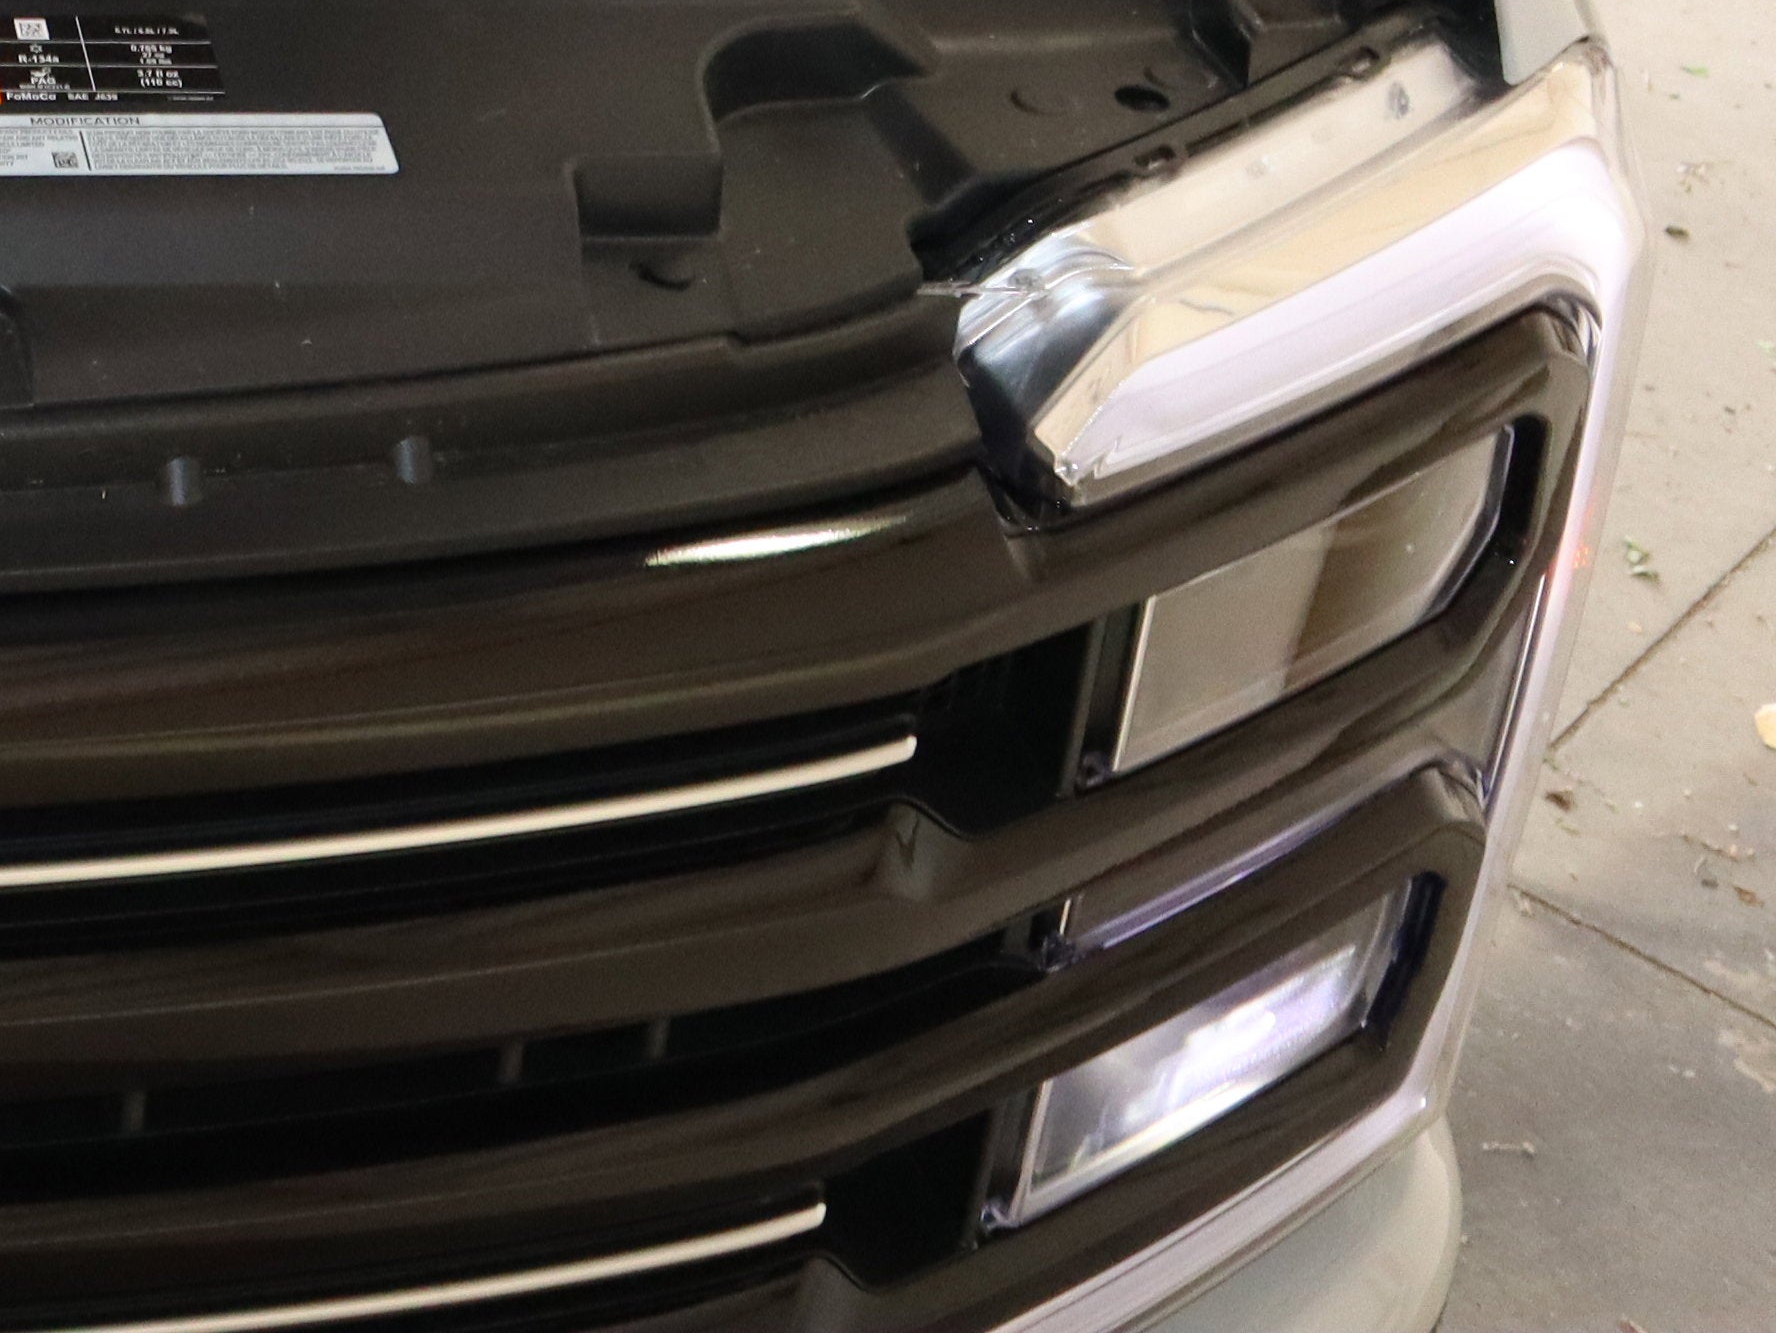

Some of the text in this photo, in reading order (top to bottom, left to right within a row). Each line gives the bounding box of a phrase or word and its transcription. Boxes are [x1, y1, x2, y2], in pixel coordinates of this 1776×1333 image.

[159, 44, 172, 54] kg
[18, 54, 59, 64] R-134a
[165, 70, 179, 78] oz
[30, 76, 56, 85] PAG
[165, 78, 183, 89] cc)
[6, 92, 56, 101] FoMoCo
[67, 93, 89, 101] SAE
[30, 117, 140, 125] MODIFICATION
